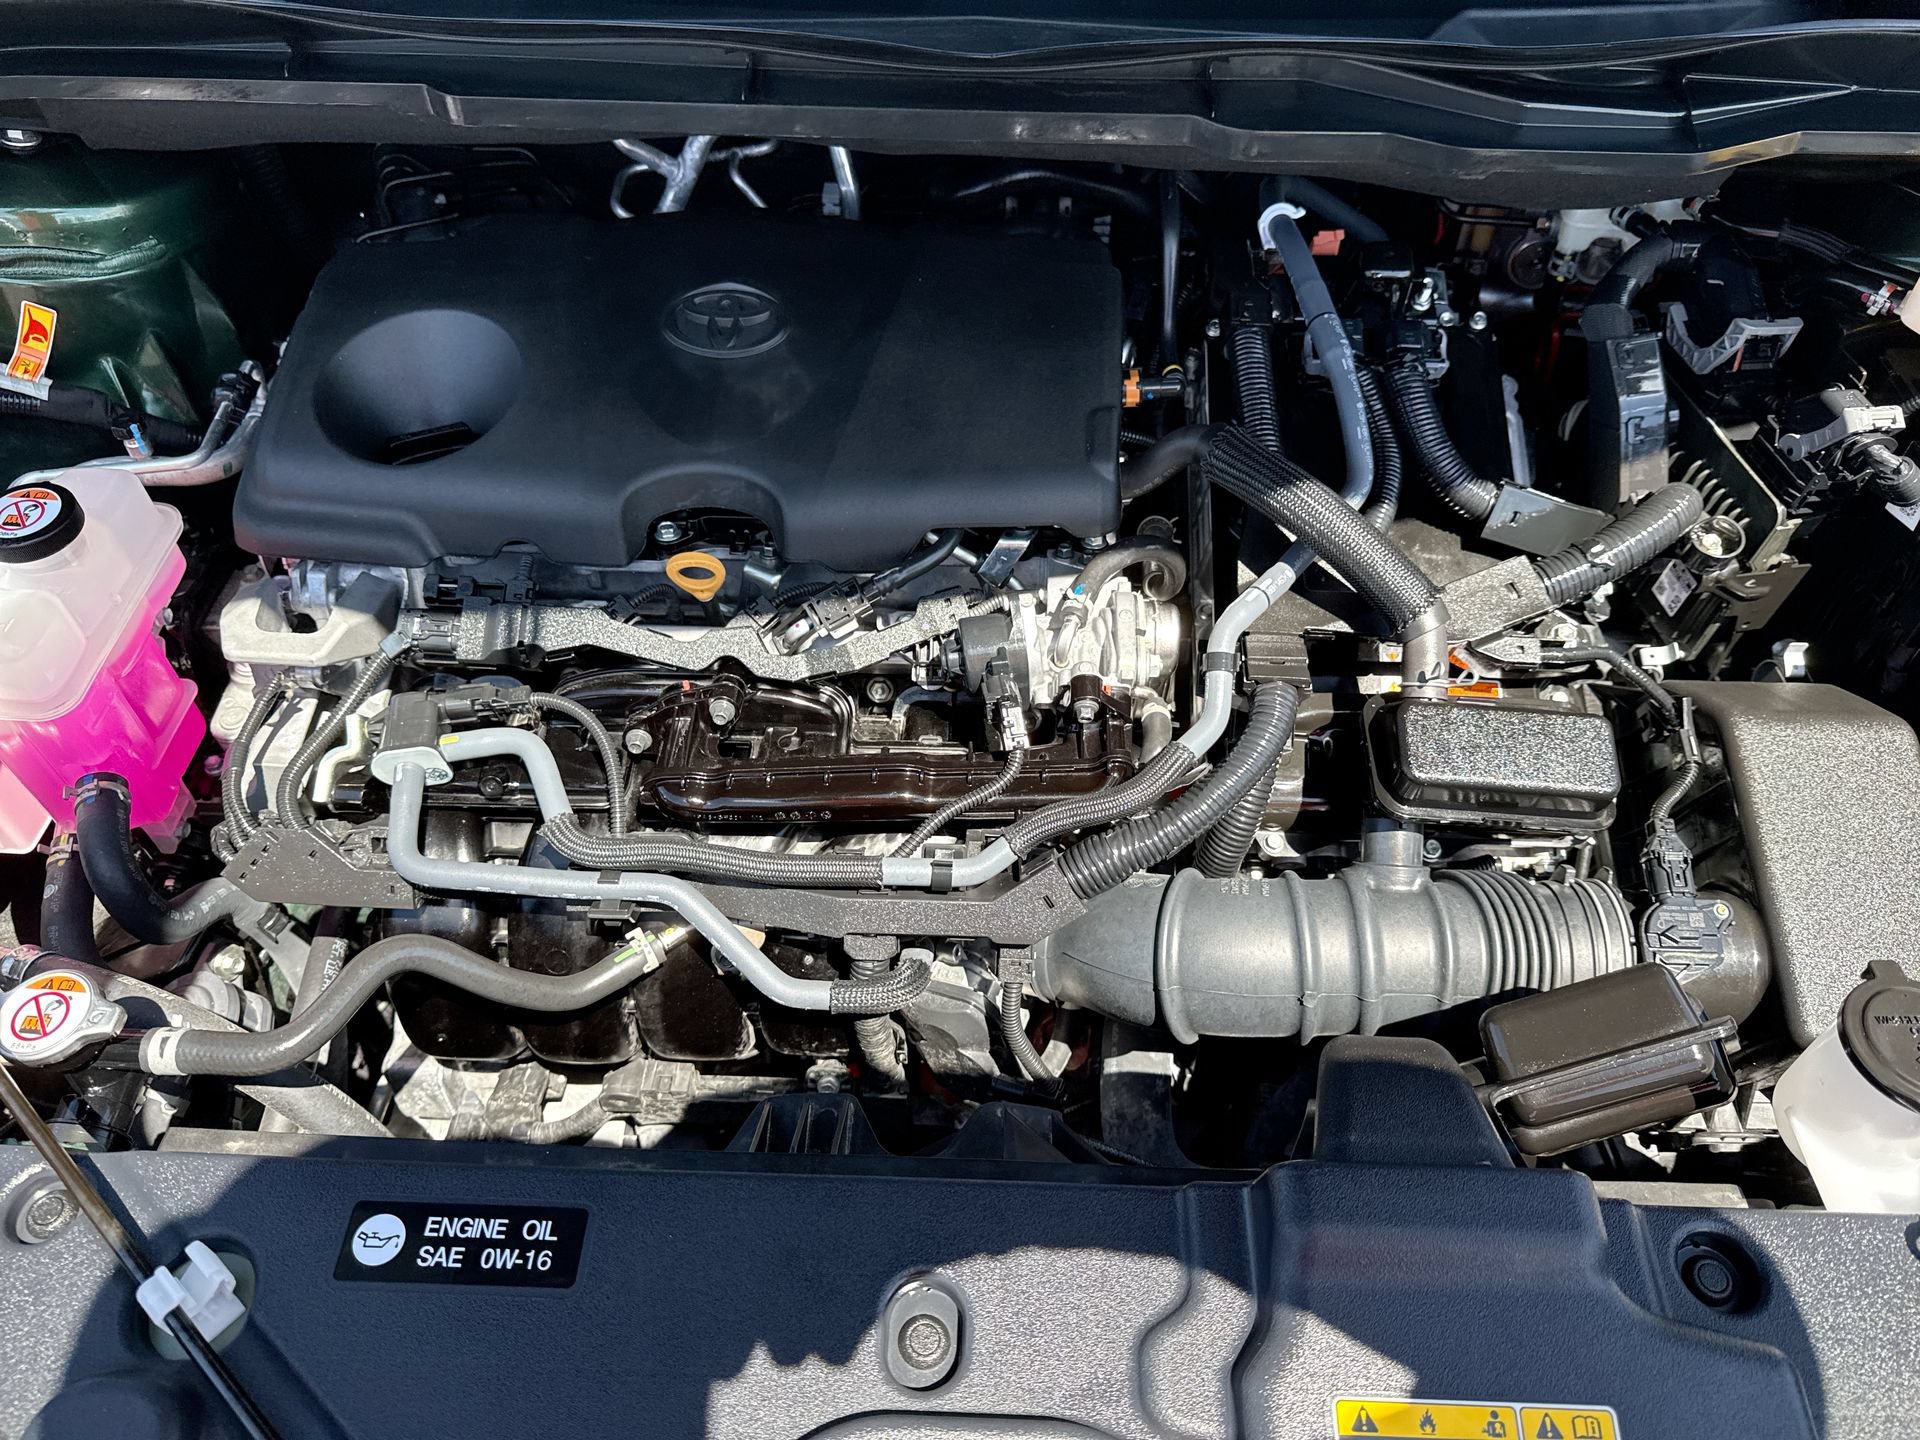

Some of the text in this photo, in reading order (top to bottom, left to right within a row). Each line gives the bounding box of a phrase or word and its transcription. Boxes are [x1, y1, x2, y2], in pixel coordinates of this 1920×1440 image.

[423, 1216, 558, 1241] ENGINE OIL
[416, 1246, 553, 1271] SAE 0W-16
